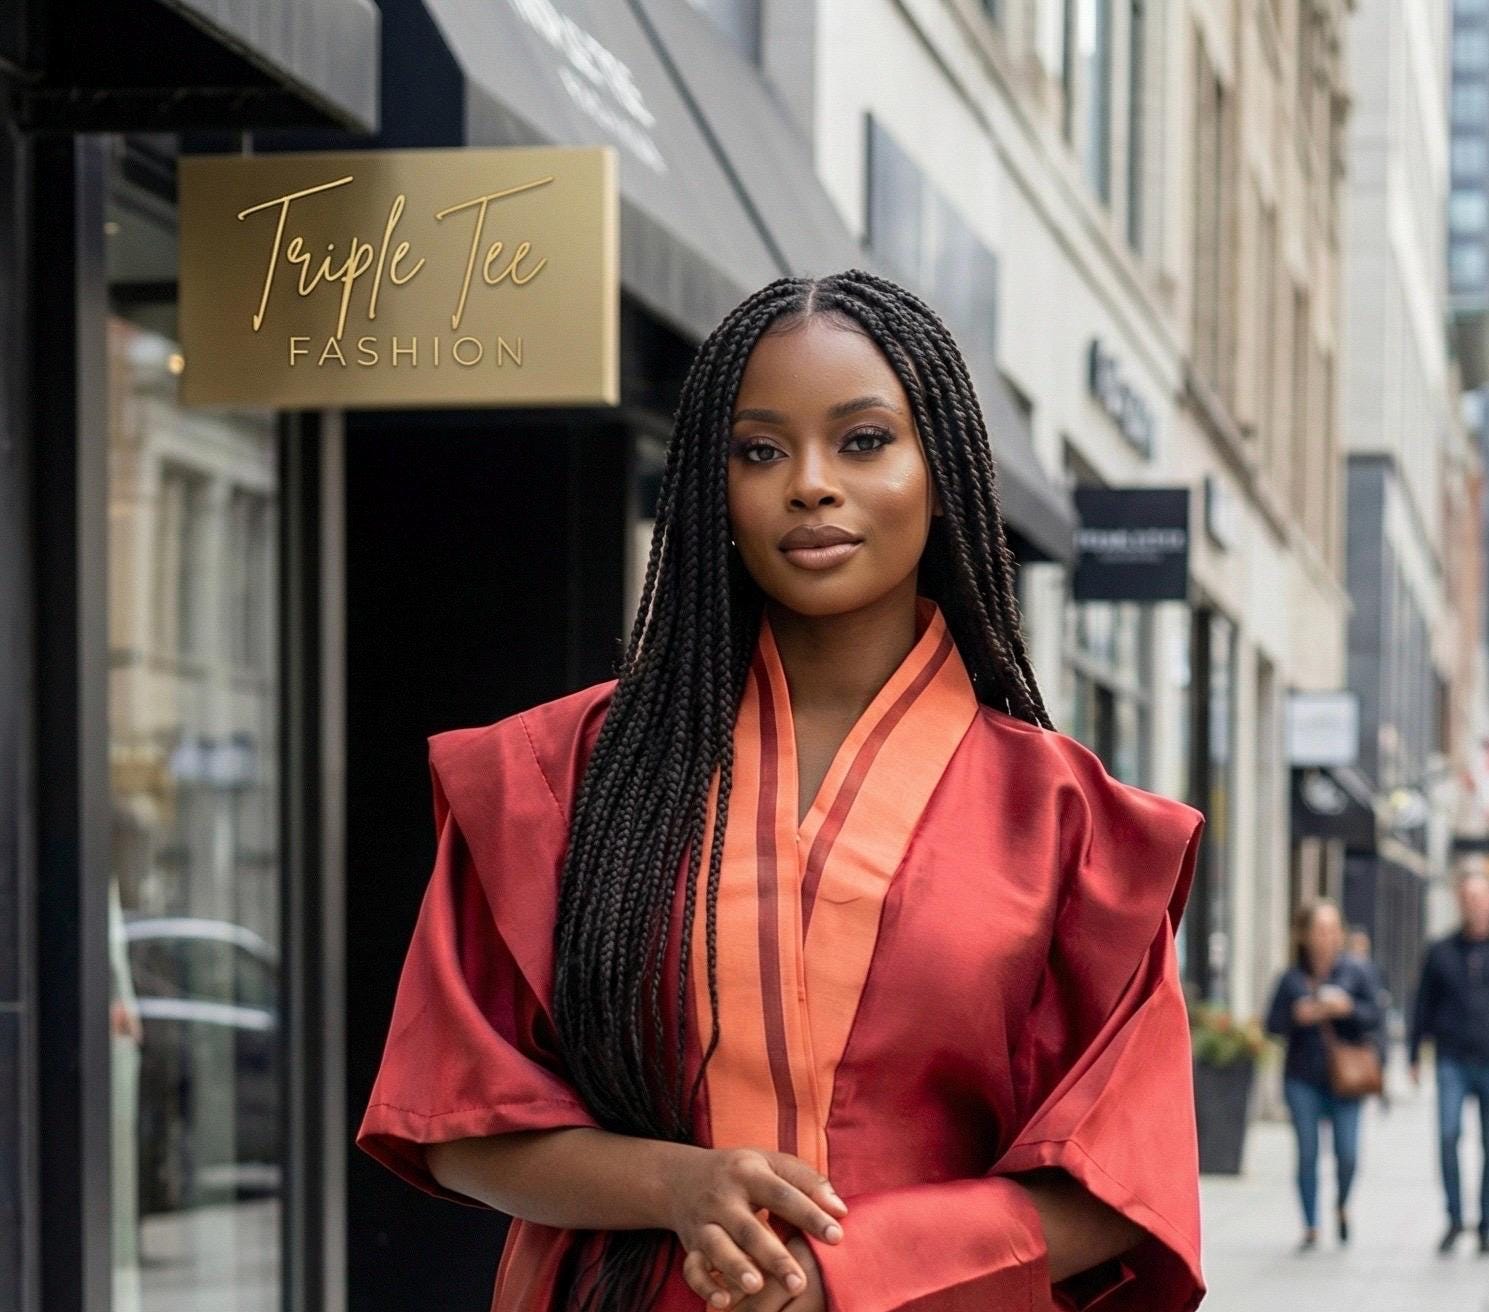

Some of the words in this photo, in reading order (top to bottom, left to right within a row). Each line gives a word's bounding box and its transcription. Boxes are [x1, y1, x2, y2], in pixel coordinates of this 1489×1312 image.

[238, 176, 425, 340] Triple
[435, 176, 554, 330] Tee
[290, 336, 522, 366] FASHION
